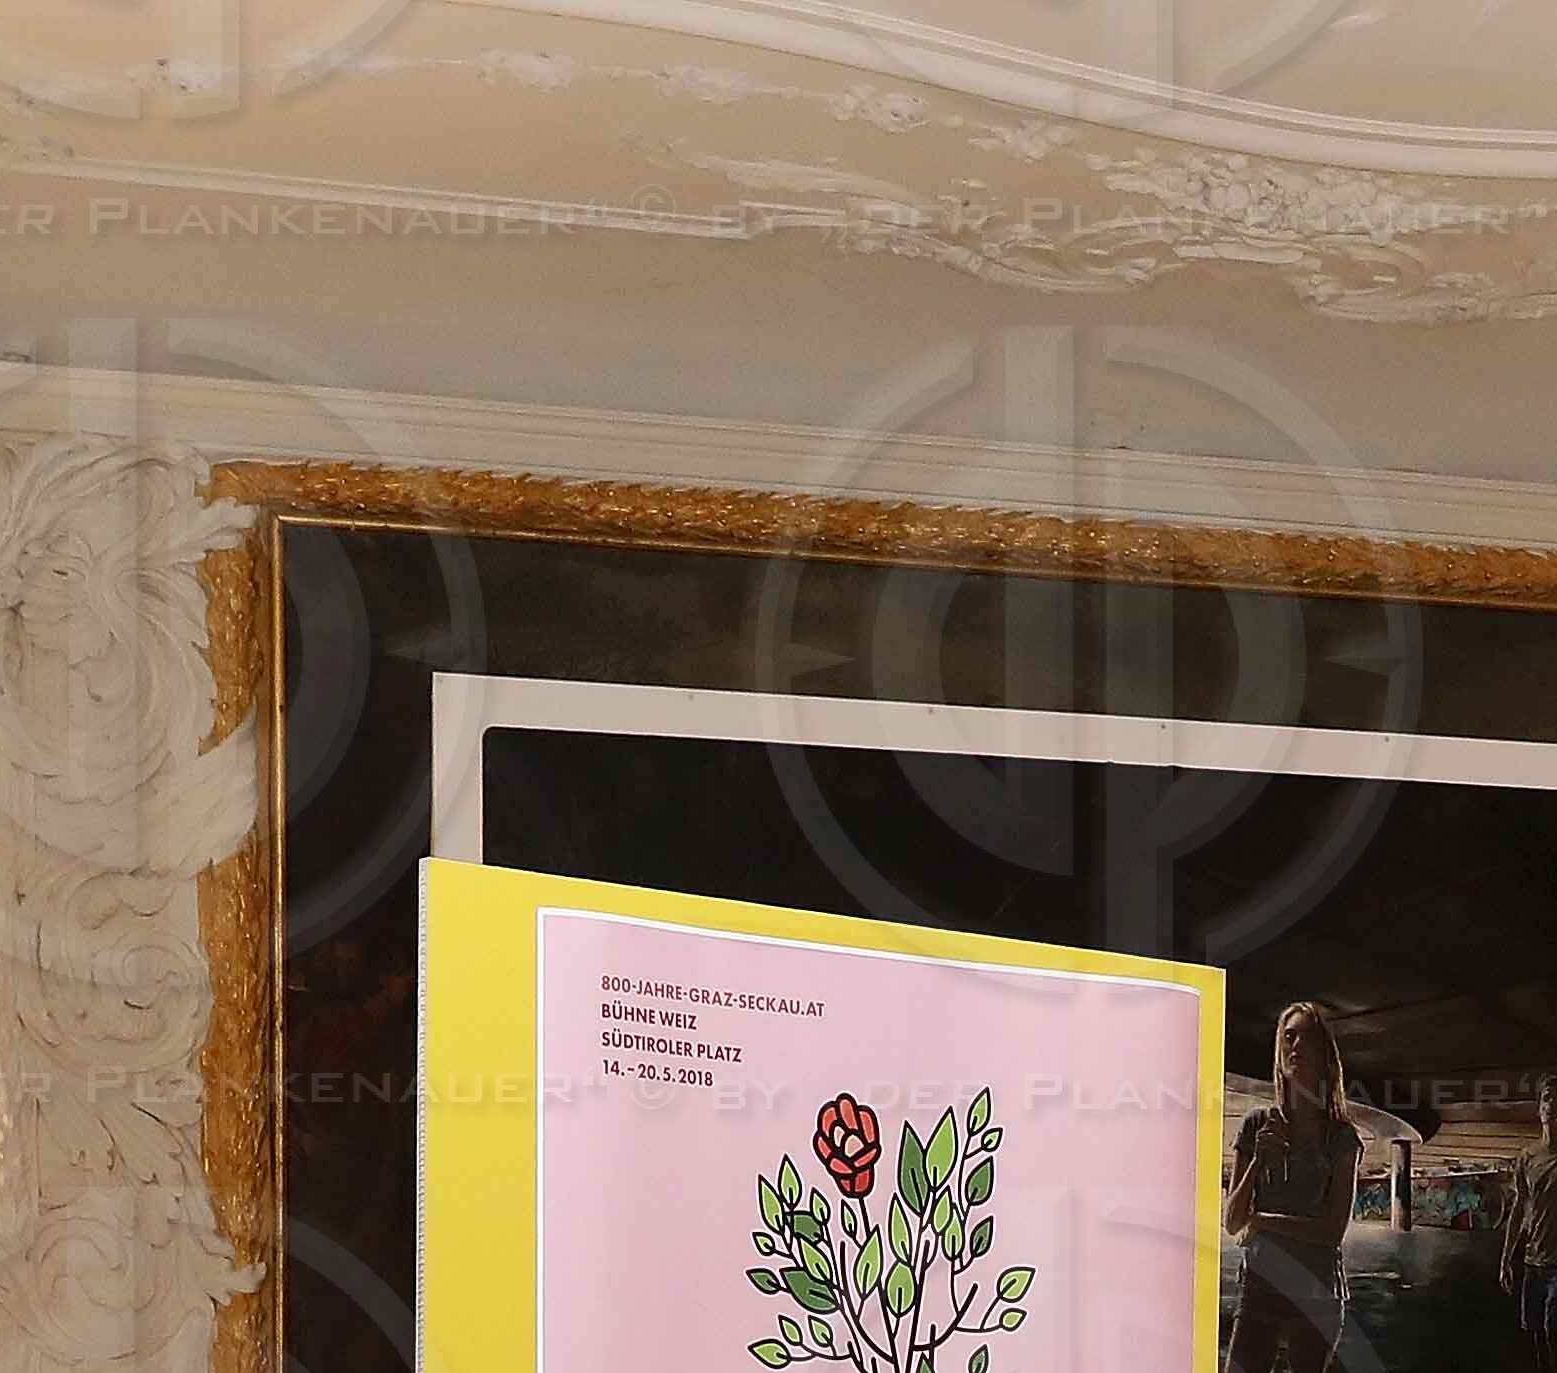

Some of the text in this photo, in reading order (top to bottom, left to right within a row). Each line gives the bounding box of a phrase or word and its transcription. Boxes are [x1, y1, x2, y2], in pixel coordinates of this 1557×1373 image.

[601, 975, 825, 1017] 800-JAHRE-GRAZ-SECKAU.AT
[601, 1003, 697, 1030] BÜHNE WEIZ
[601, 1029, 742, 1063] SÜDTIROLER PLATZ
